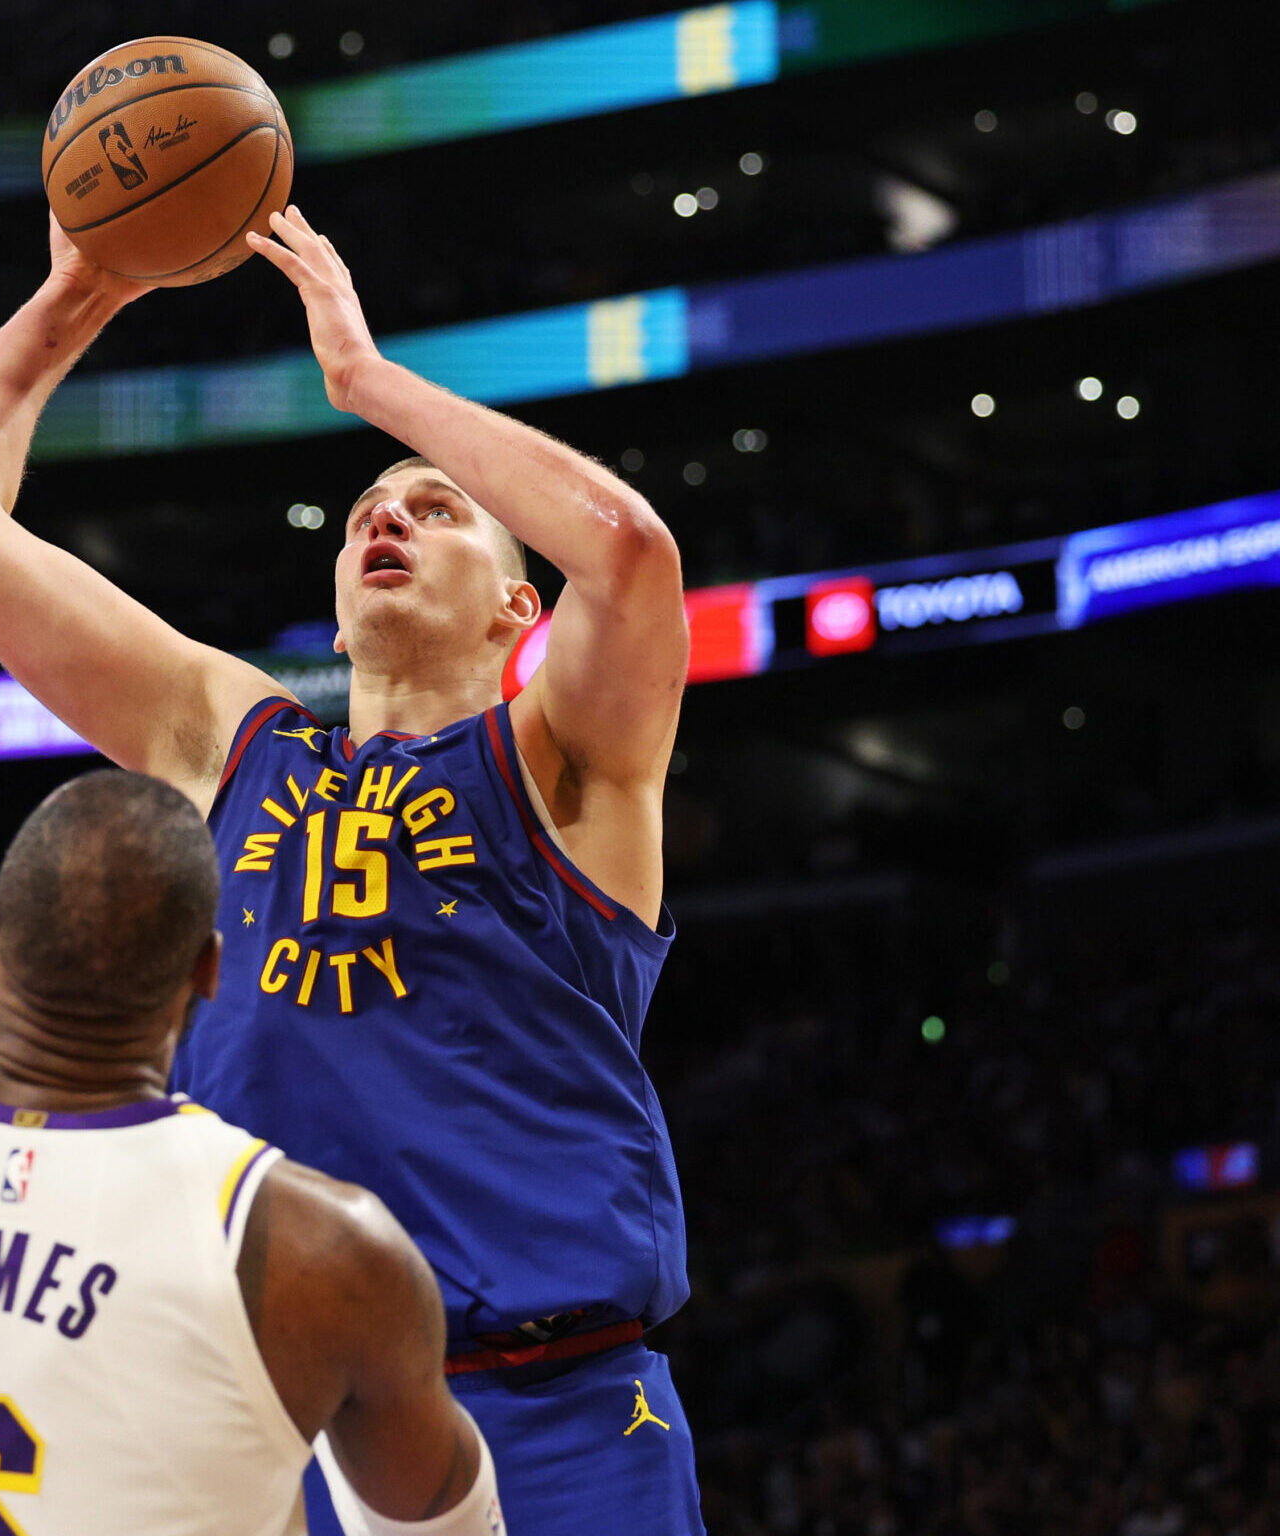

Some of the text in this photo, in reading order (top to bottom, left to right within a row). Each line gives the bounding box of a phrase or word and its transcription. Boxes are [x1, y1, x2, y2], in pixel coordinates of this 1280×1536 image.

[48, 54, 188, 142] Wilson
[875, 571, 1023, 631] TOYOTA
[354, 764, 477, 873] HIGH
[301, 808, 395, 926] 15
[259, 933, 409, 1015] CITY
